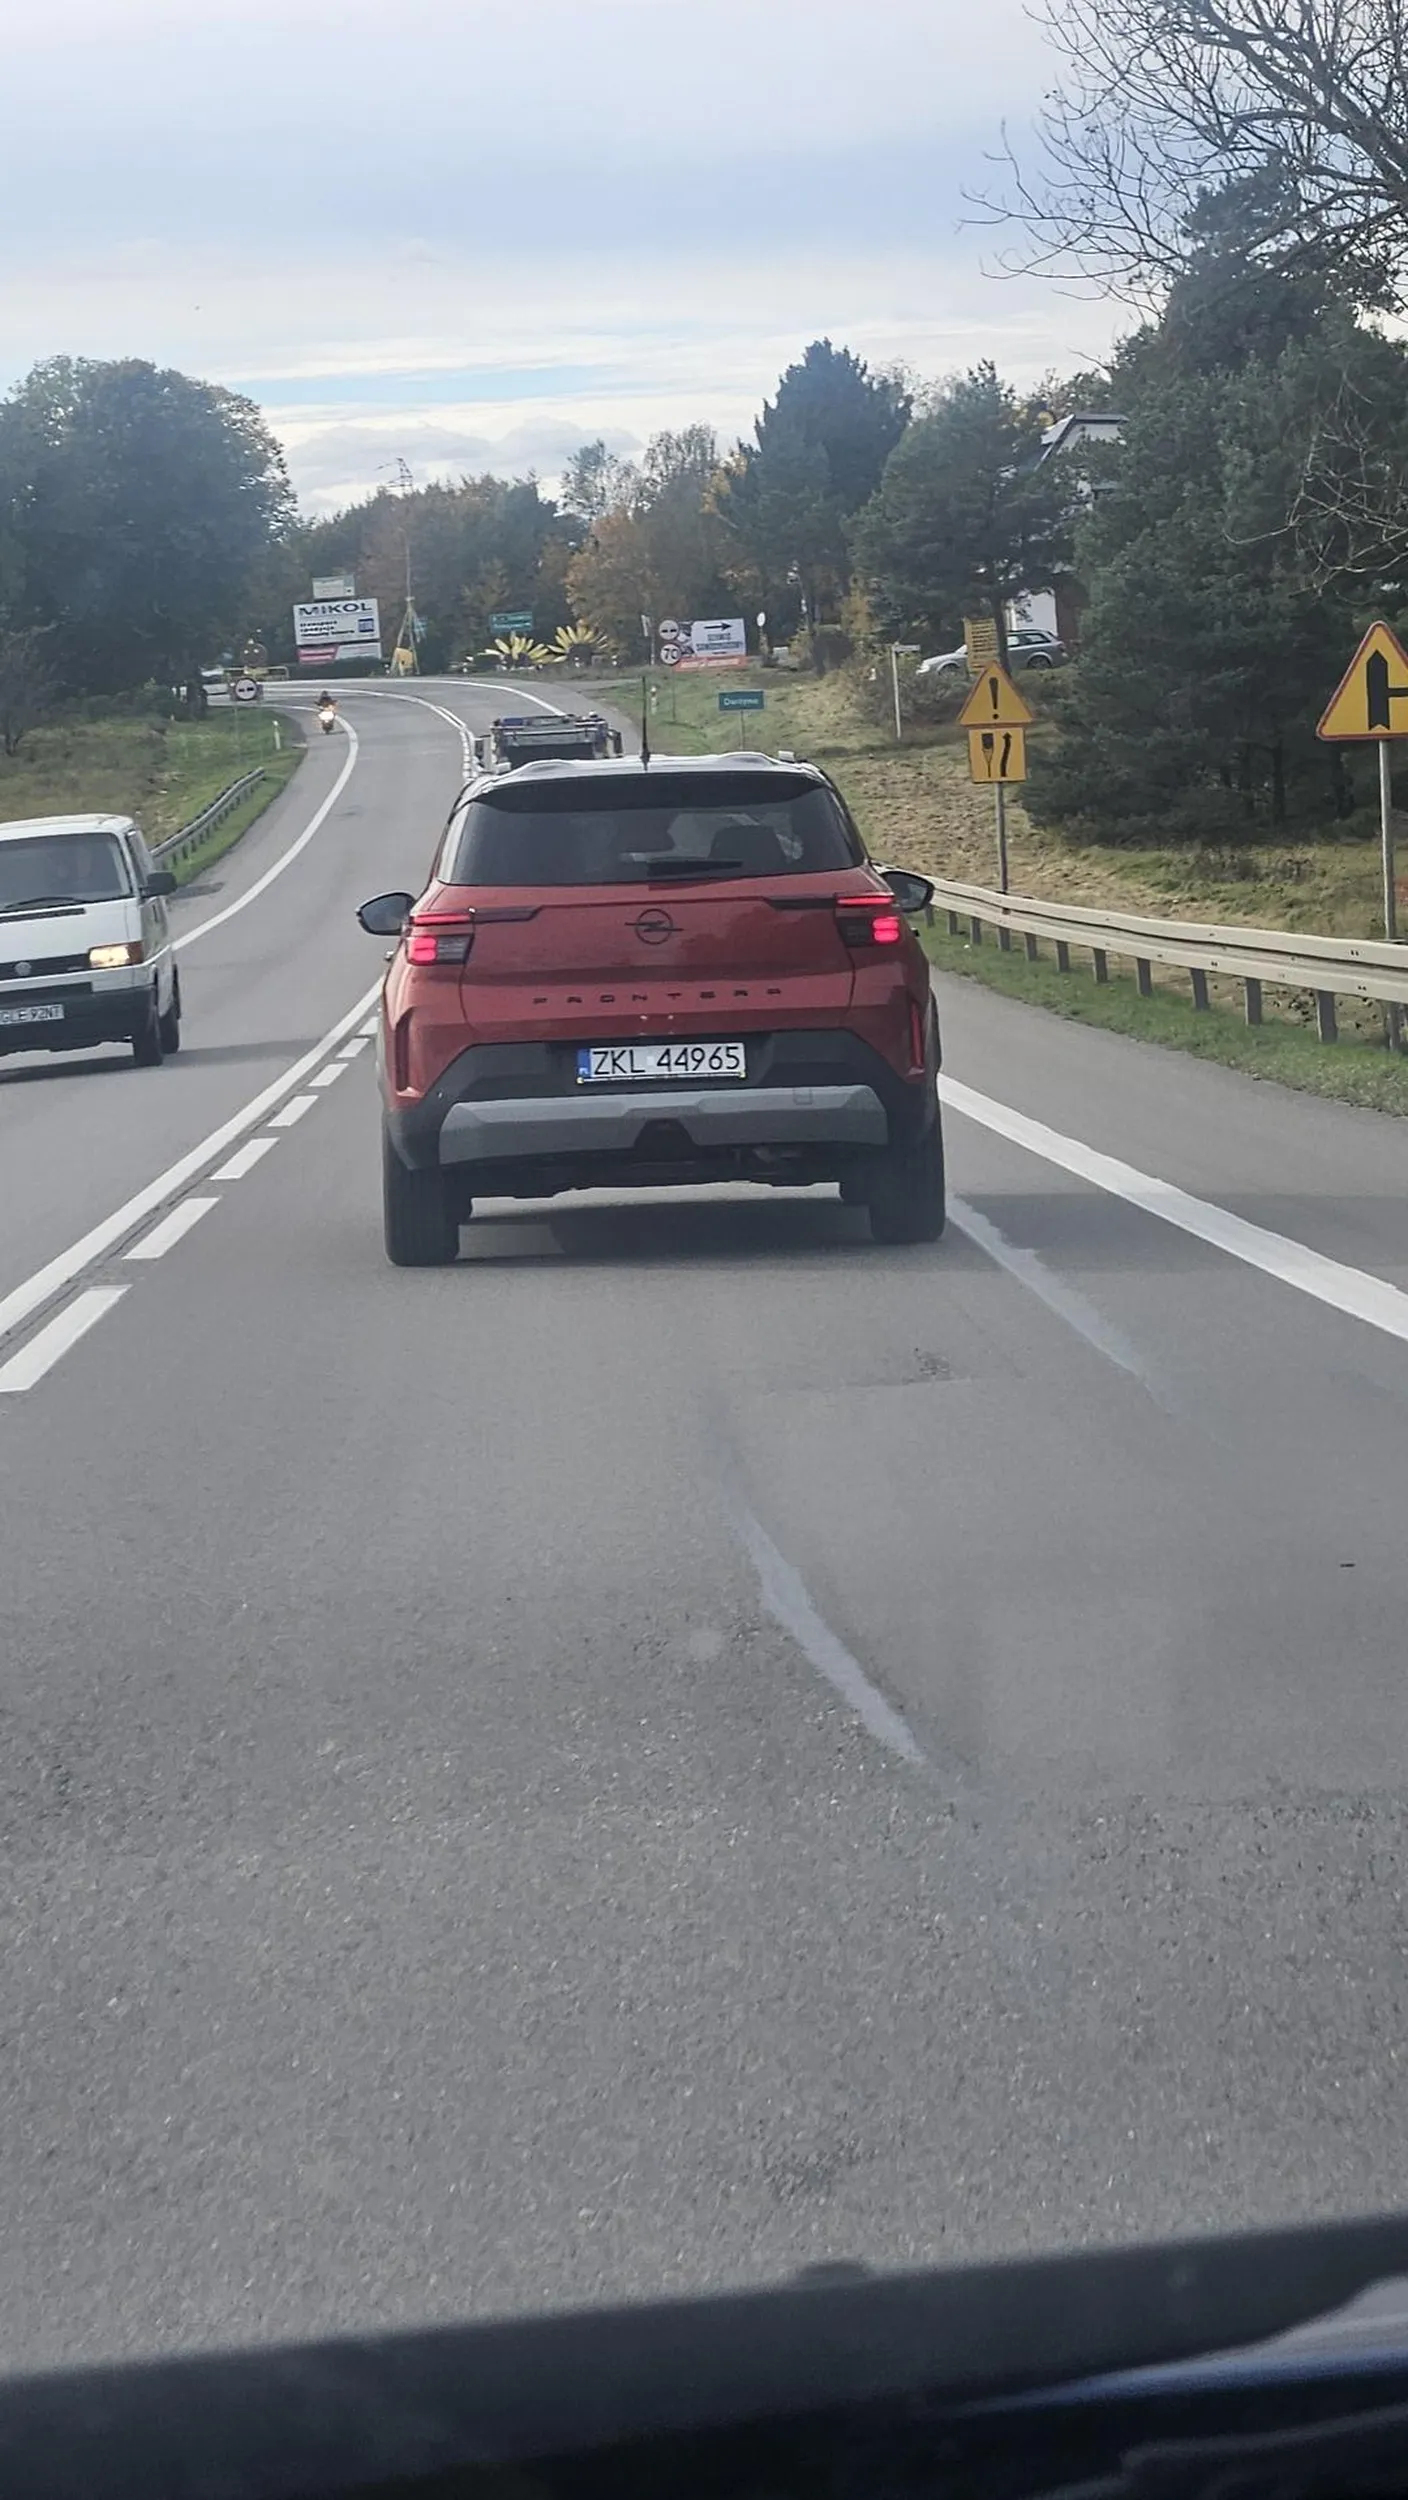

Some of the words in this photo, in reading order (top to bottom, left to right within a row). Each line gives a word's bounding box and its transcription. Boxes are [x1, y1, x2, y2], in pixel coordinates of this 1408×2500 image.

[299, 603, 372, 615] MIKOL
[663, 648, 678, 660] 70
[533, 988, 782, 1005] FRONTERA
[593, 1050, 645, 1075] ZKL
[656, 1046, 740, 1073] 44965
